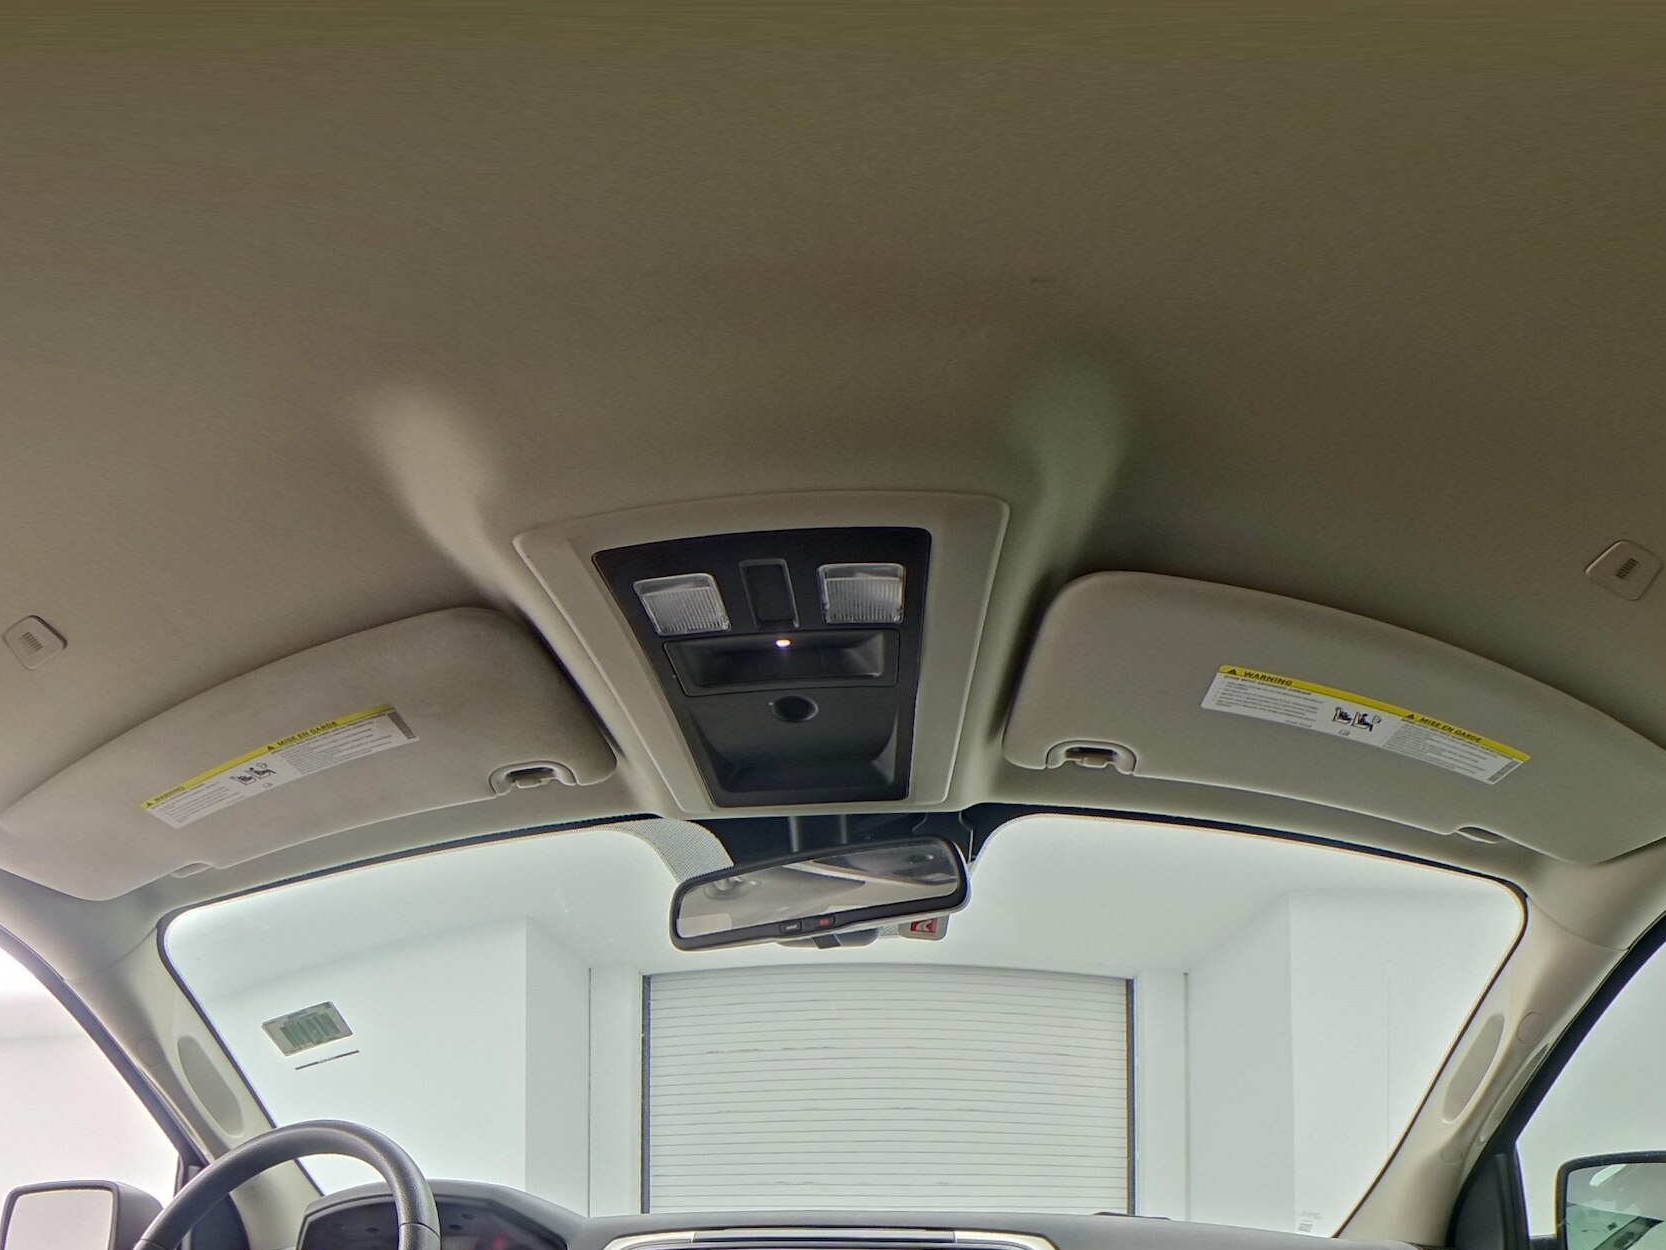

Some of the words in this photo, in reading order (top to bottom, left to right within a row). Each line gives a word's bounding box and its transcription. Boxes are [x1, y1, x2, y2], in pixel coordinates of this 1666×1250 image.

[1244, 671, 1293, 686] WARNING
[277, 736, 295, 746] MISE
[297, 730, 309, 739] EN
[311, 721, 338, 736] GARDE
[1420, 717, 1442, 728] MISE
[1455, 729, 1483, 741] GARDE
